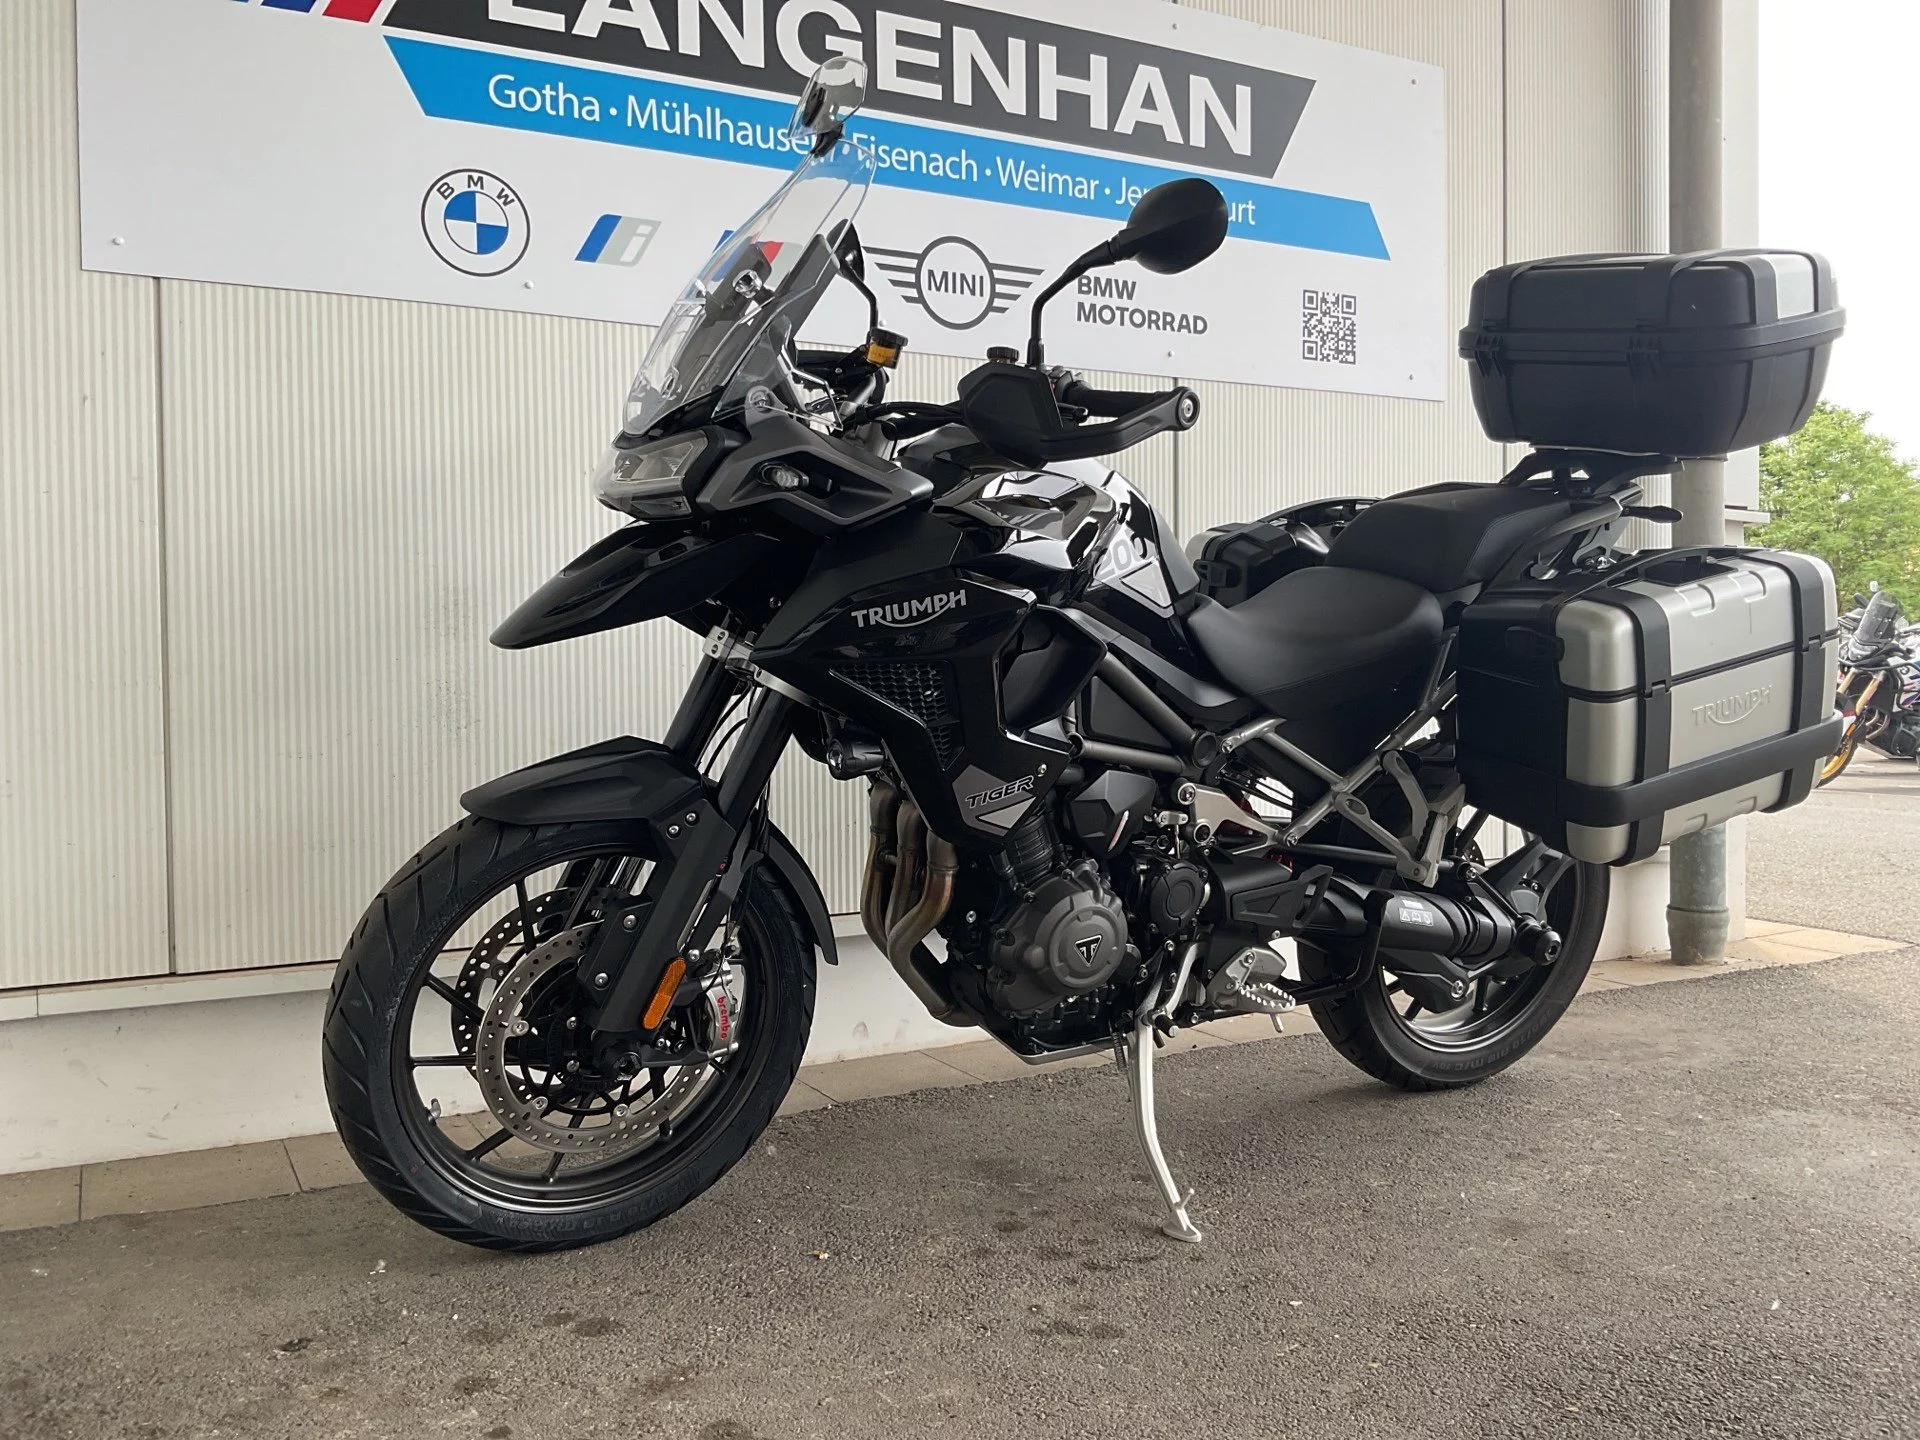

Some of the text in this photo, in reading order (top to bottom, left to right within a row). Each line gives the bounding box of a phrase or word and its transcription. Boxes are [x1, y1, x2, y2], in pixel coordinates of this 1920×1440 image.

[488, 0, 1251, 156] ANGENHAN
[488, 74, 600, 122] Gotha
[852, 131, 978, 182] Eisenach
[996, 156, 1099, 200] Weimar
[436, 174, 515, 208] BMW
[927, 269, 984, 297] MINI
[1077, 275, 1137, 300] BMW
[1076, 301, 1208, 335] MOTORRAD
[851, 589, 967, 628] TRIUMPH
[1692, 685, 1773, 726] TRIUMPH
[966, 775, 1034, 808] TIGER
[717, 996, 731, 1040] brembo
